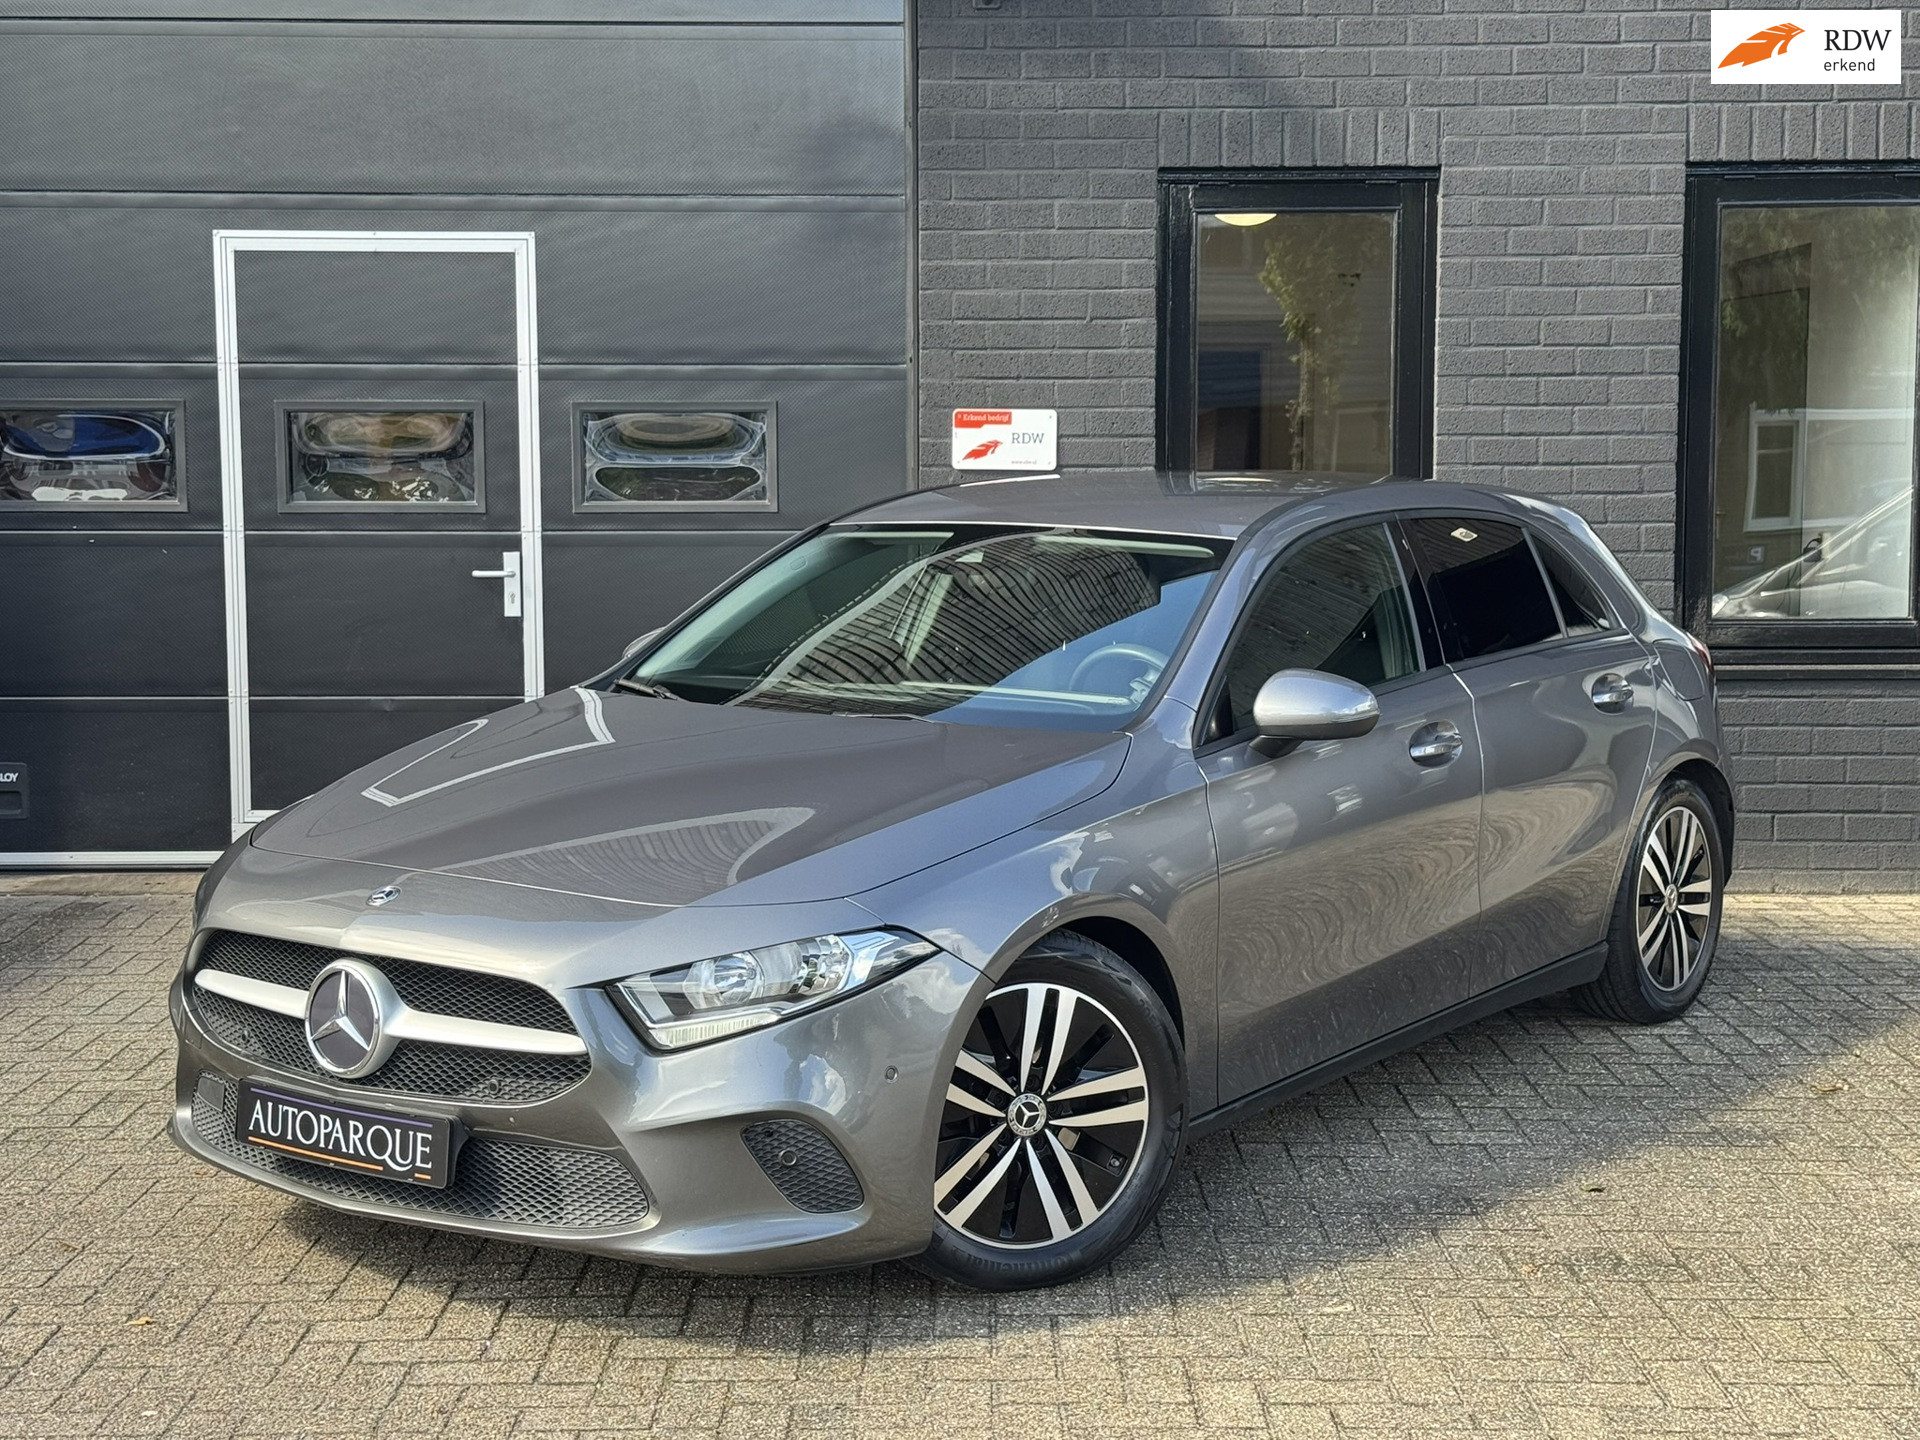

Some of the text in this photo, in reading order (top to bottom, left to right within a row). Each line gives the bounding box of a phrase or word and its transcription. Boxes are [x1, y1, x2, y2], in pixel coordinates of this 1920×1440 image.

[963, 413, 1009, 423] Erkend bedrijf
[1011, 432, 1045, 445] RDW
[0, 772, 19, 782] LOY
[248, 1098, 433, 1171] AUTOPARQUE
